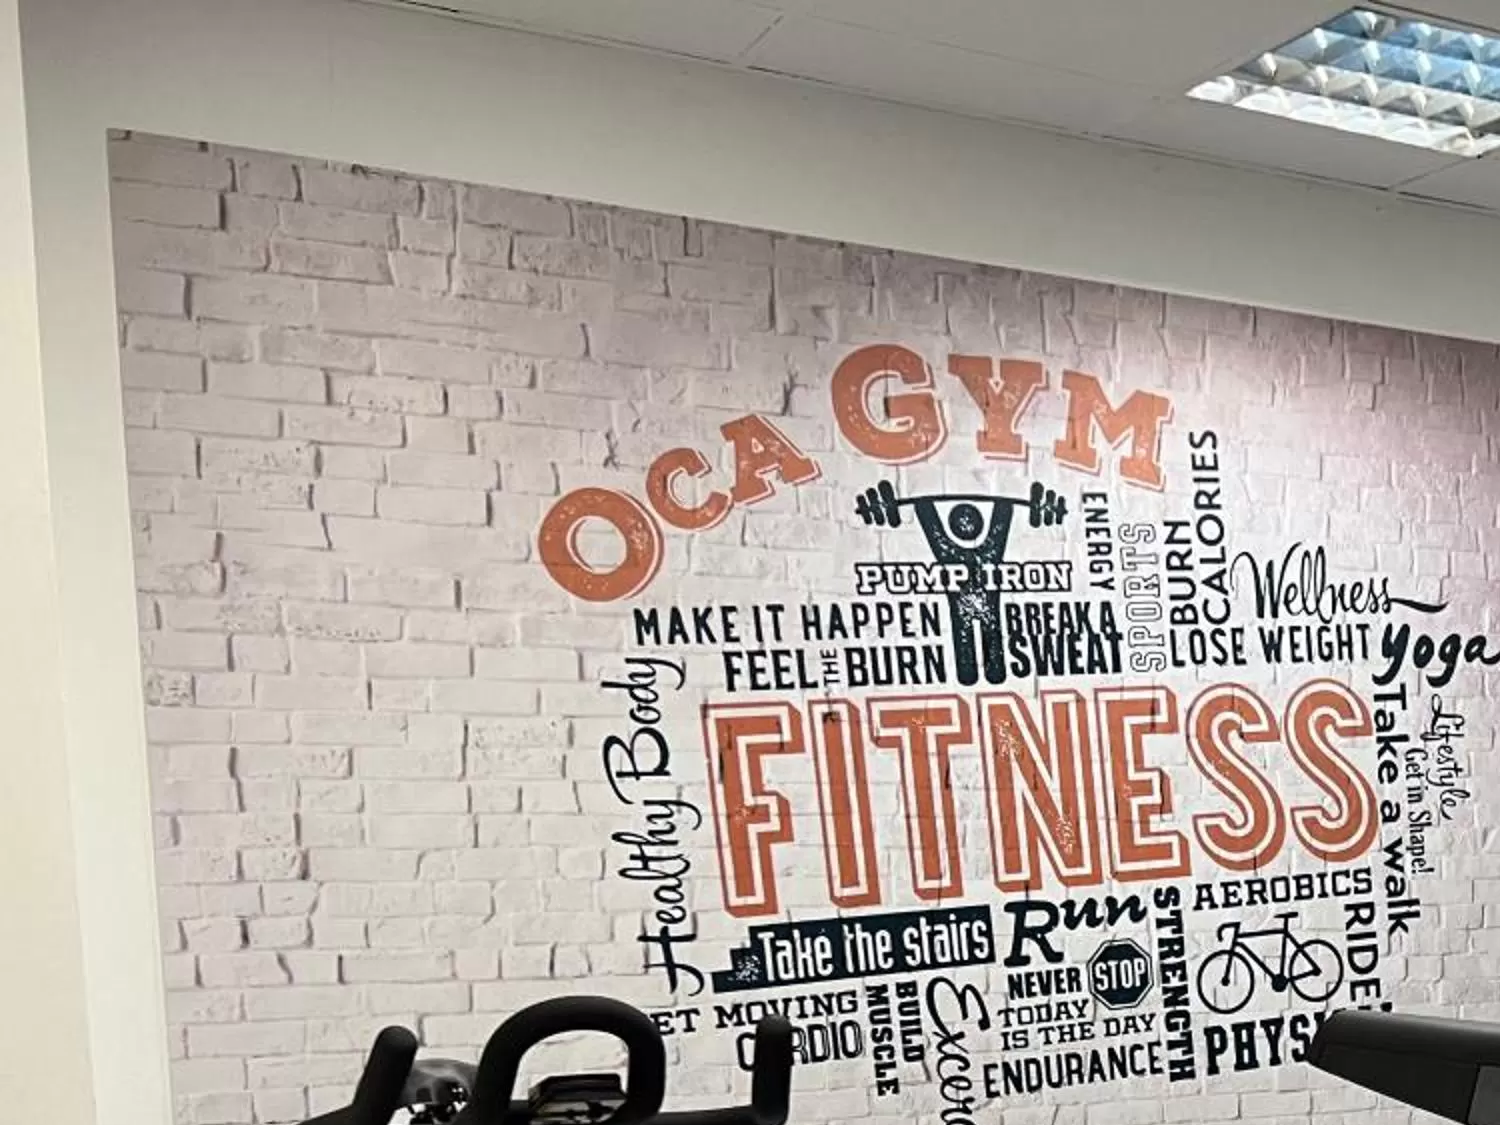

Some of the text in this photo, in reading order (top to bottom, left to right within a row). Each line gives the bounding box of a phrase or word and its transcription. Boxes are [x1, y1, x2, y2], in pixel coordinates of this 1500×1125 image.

[538, 344, 1176, 602] OCA GYM
[1081, 492, 1116, 591] ENERGY
[1188, 430, 1232, 626] CALORIES
[855, 560, 1072, 595] PUMP IRON
[1118, 522, 1167, 673] SPORTS
[1163, 520, 1199, 626] BURN
[1230, 542, 1448, 624] Wellness
[633, 601, 942, 646] MAKE IT HAPPEN
[1005, 601, 1118, 637] BREAK A
[1170, 624, 1370, 668] LOSE WEIGHT
[722, 645, 947, 692] FEEL THE BURN
[1009, 632, 1124, 678] SWEAT
[1420, 693, 1471, 821] Lifestyle
[601, 657, 705, 996] Healthy Body
[700, 677, 1379, 918] FITNESS
[1373, 682, 1421, 935] Take a walk
[1404, 747, 1435, 875] Get in Shape!
[1193, 867, 1373, 911] AEROBICS
[757, 914, 991, 983] Take the stairs
[1003, 897, 1147, 968] Run
[1344, 901, 1381, 1002] RIDE
[650, 990, 859, 1036] ET MOVING
[997, 998, 1089, 1028] TODAY
[1007, 960, 1147, 1001] NEVER STOP
[1153, 886, 1196, 1083] STRENGTH
[736, 1019, 864, 1072] CRDIO
[866, 983, 900, 1097] MUSCLE
[896, 980, 925, 1063] BUILD
[1001, 1012, 1158, 1051] IS THE DAY
[1204, 1010, 1326, 1076] PHYS
[983, 1040, 1164, 1099] ENDURANCE
